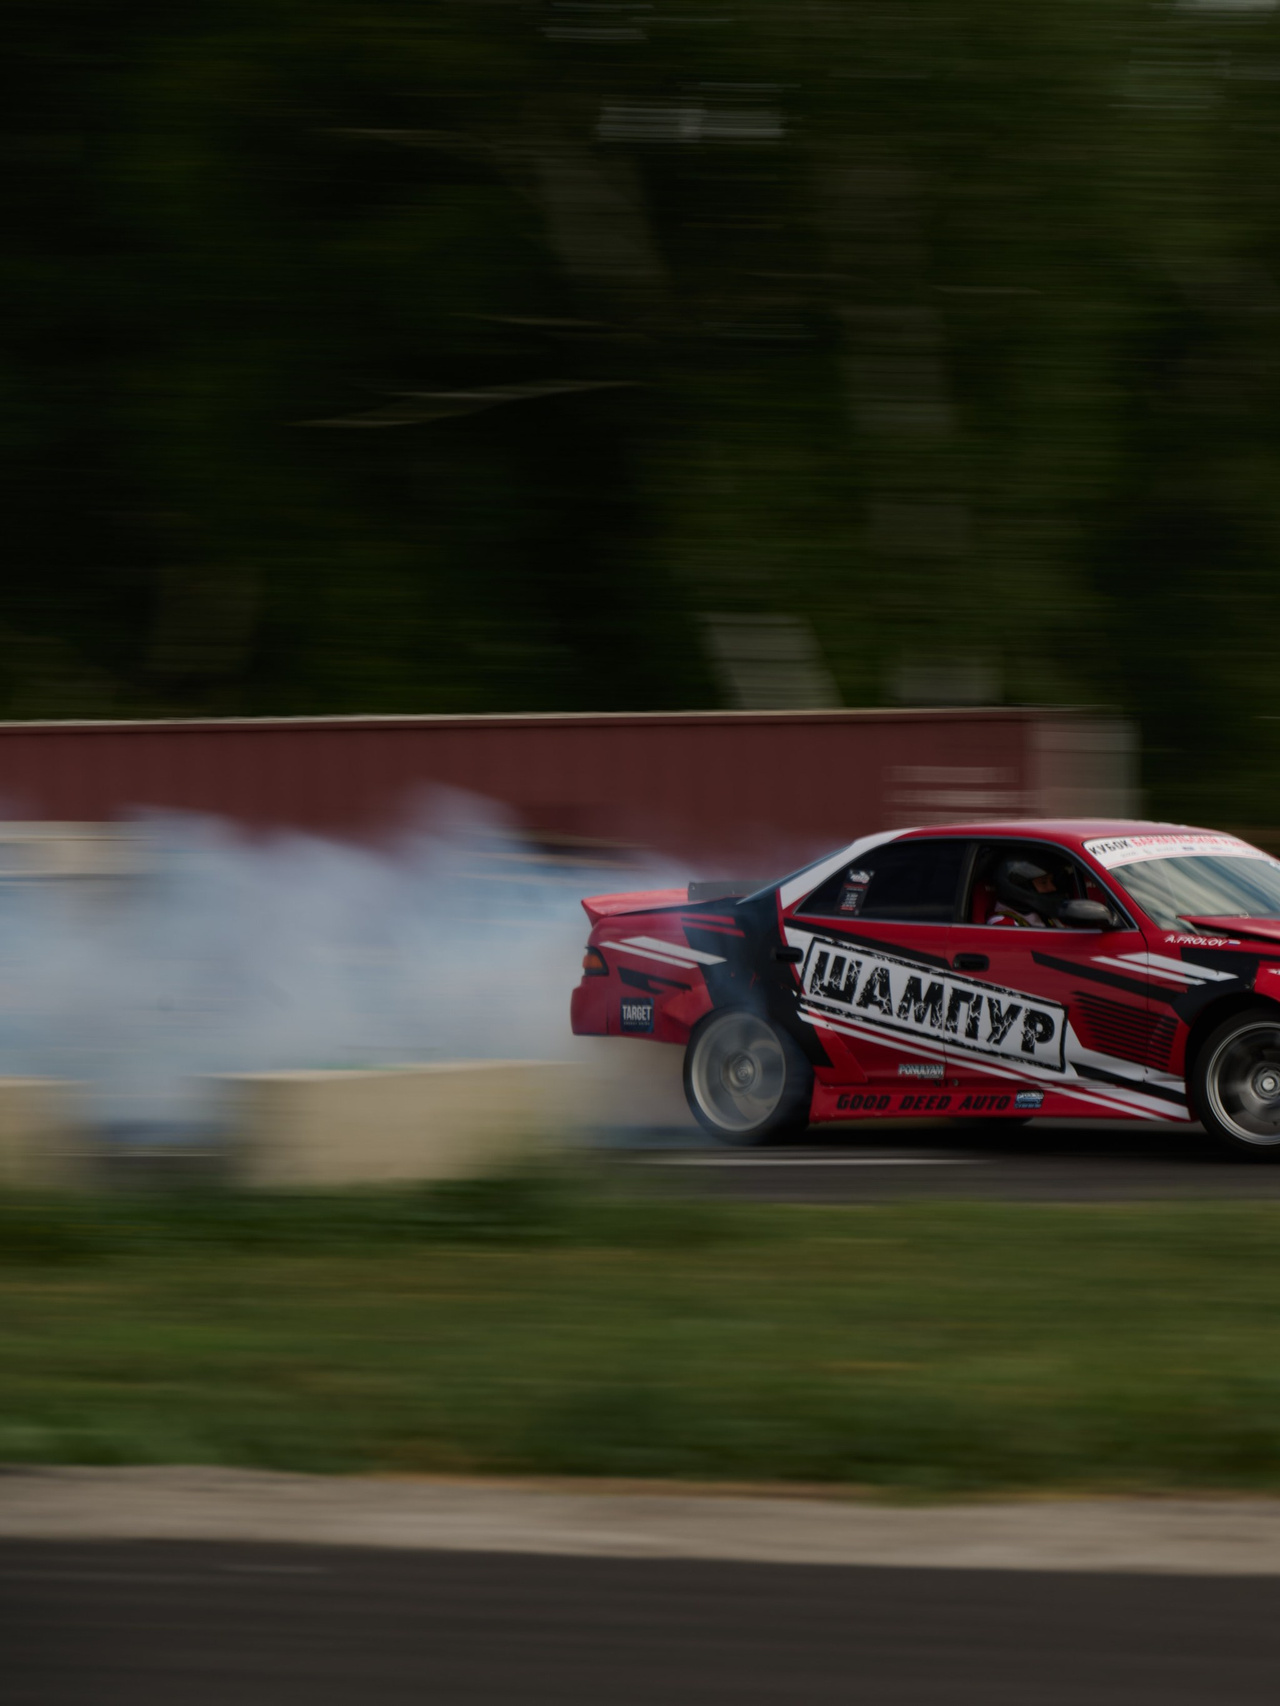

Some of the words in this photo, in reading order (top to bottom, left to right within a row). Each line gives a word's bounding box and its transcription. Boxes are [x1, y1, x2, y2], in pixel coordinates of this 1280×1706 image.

[1088, 839, 1132, 855] КУБОК
[1164, 934, 1229, 947] A.FROLOV
[809, 951, 1056, 1054] ШАМПУР
[621, 1004, 652, 1021] TARGET
[836, 1093, 891, 1110] GOOD
[898, 1094, 952, 1110] DEED
[958, 1094, 1012, 1110] AUTO
